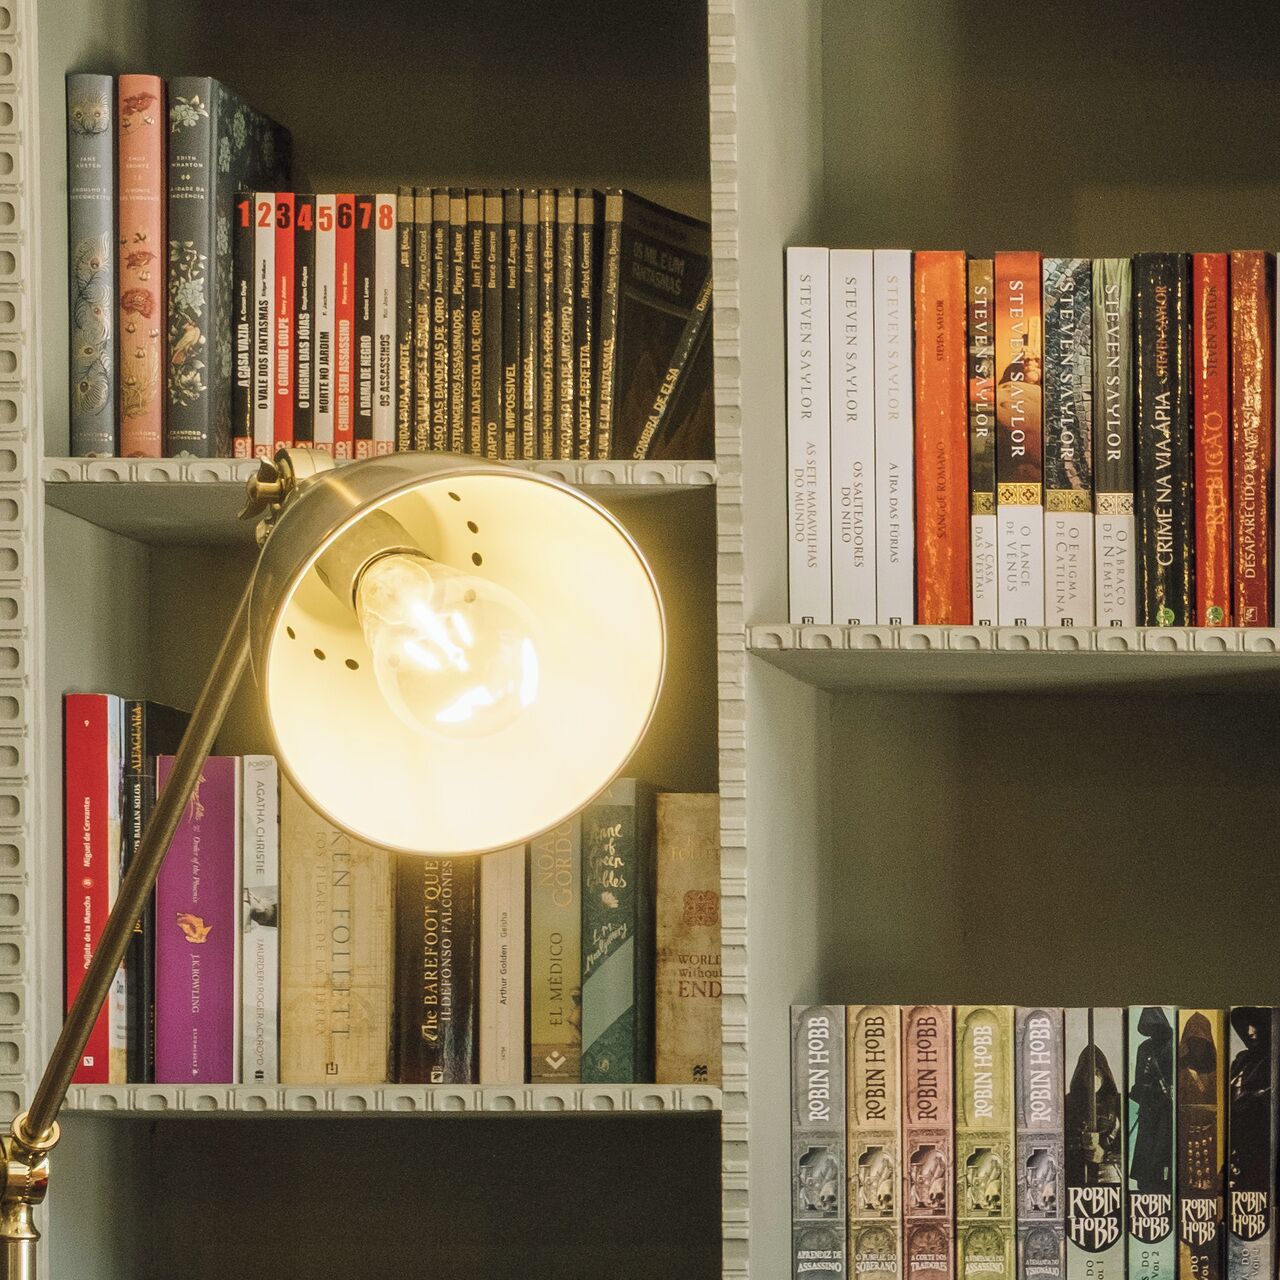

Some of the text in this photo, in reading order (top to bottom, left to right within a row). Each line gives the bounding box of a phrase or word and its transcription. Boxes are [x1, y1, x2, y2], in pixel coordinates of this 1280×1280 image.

[239, 202, 250, 227] 1
[258, 202, 271, 227] 2
[277, 203, 290, 228] 3
[298, 203, 312, 229] 4
[318, 206, 333, 231] 5
[337, 203, 352, 229] 6
[360, 204, 371, 228] 7
[378, 205, 393, 230] 8
[845, 276, 858, 423] STEVEN SAYLOR
[975, 285, 988, 438] STEVEN SAYLOR
[256, 781, 264, 875] AGATHA CHRISTIE
[547, 932, 563, 1026] EL MÉDICO
[808, 1016, 829, 1121] ROBIN HOBB
[865, 1016, 885, 1121] ROBIN HOBB
[917, 1016, 938, 1121] ROBIN HOBB
[973, 1025, 993, 1118] ROBIN HOBB
[1070, 1187, 1121, 1216] ROBIN
[1071, 1216, 1119, 1248] HOBB
